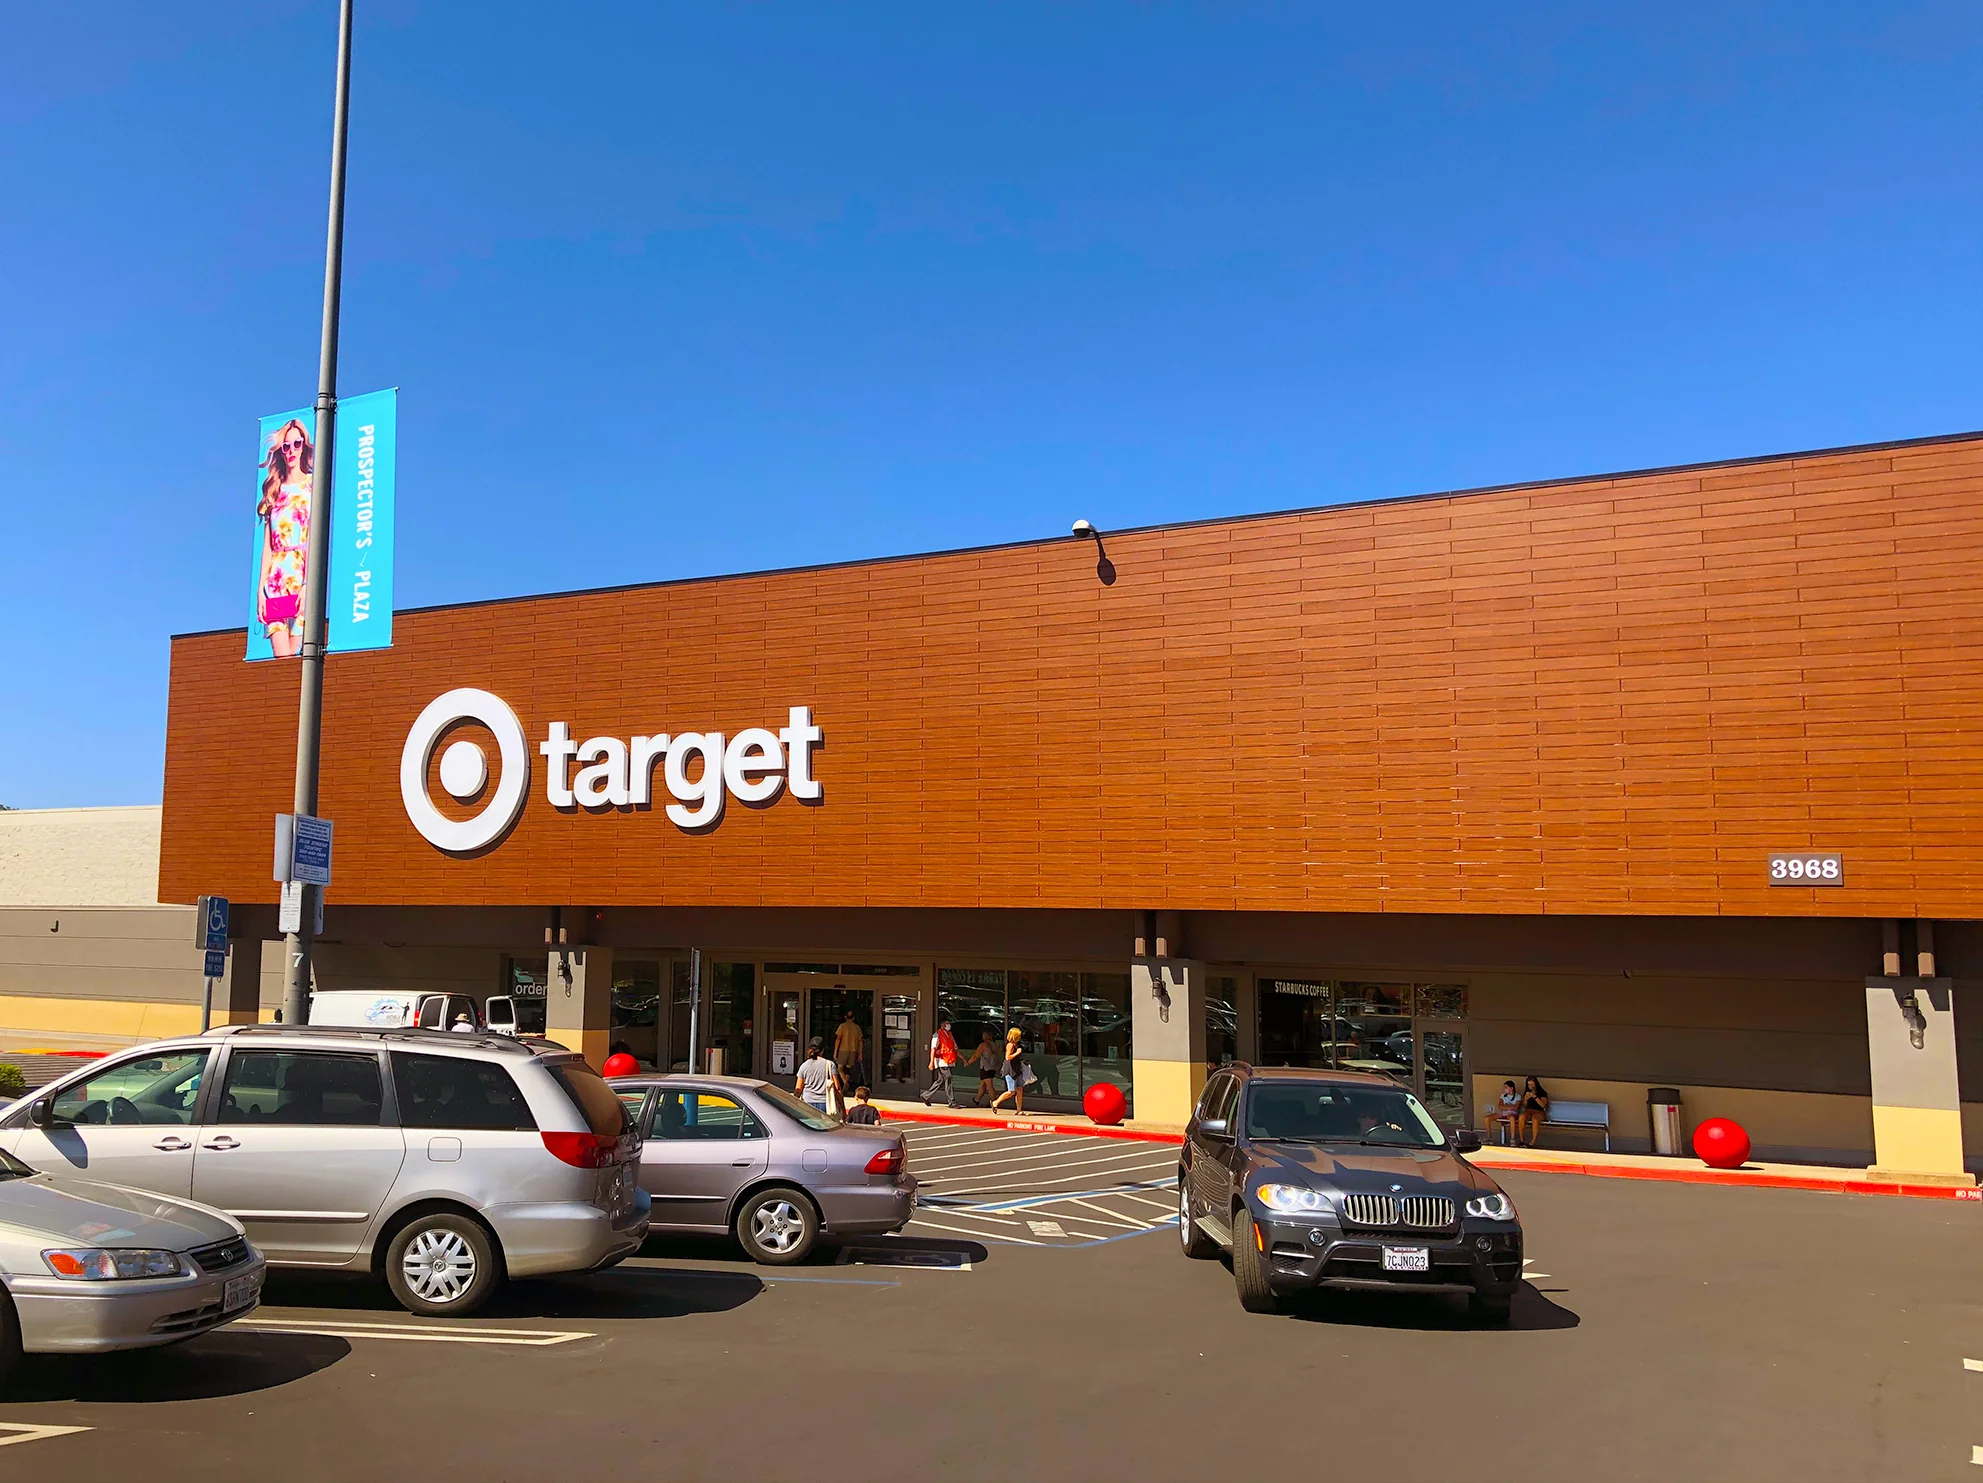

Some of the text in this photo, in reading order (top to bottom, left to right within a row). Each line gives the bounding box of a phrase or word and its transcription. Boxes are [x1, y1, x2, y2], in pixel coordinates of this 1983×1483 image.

[352, 424, 375, 623] PROSPECTOR'S PLAZA
[540, 706, 822, 828] target
[1771, 859, 1839, 879] 3968
[292, 952, 304, 968] 7
[515, 982, 548, 996] order
[1275, 981, 1329, 997] STARBUCKS COFFEE
[1955, 1190, 1966, 1198] NO
[1386, 1255, 1426, 1267] 7CJN023
